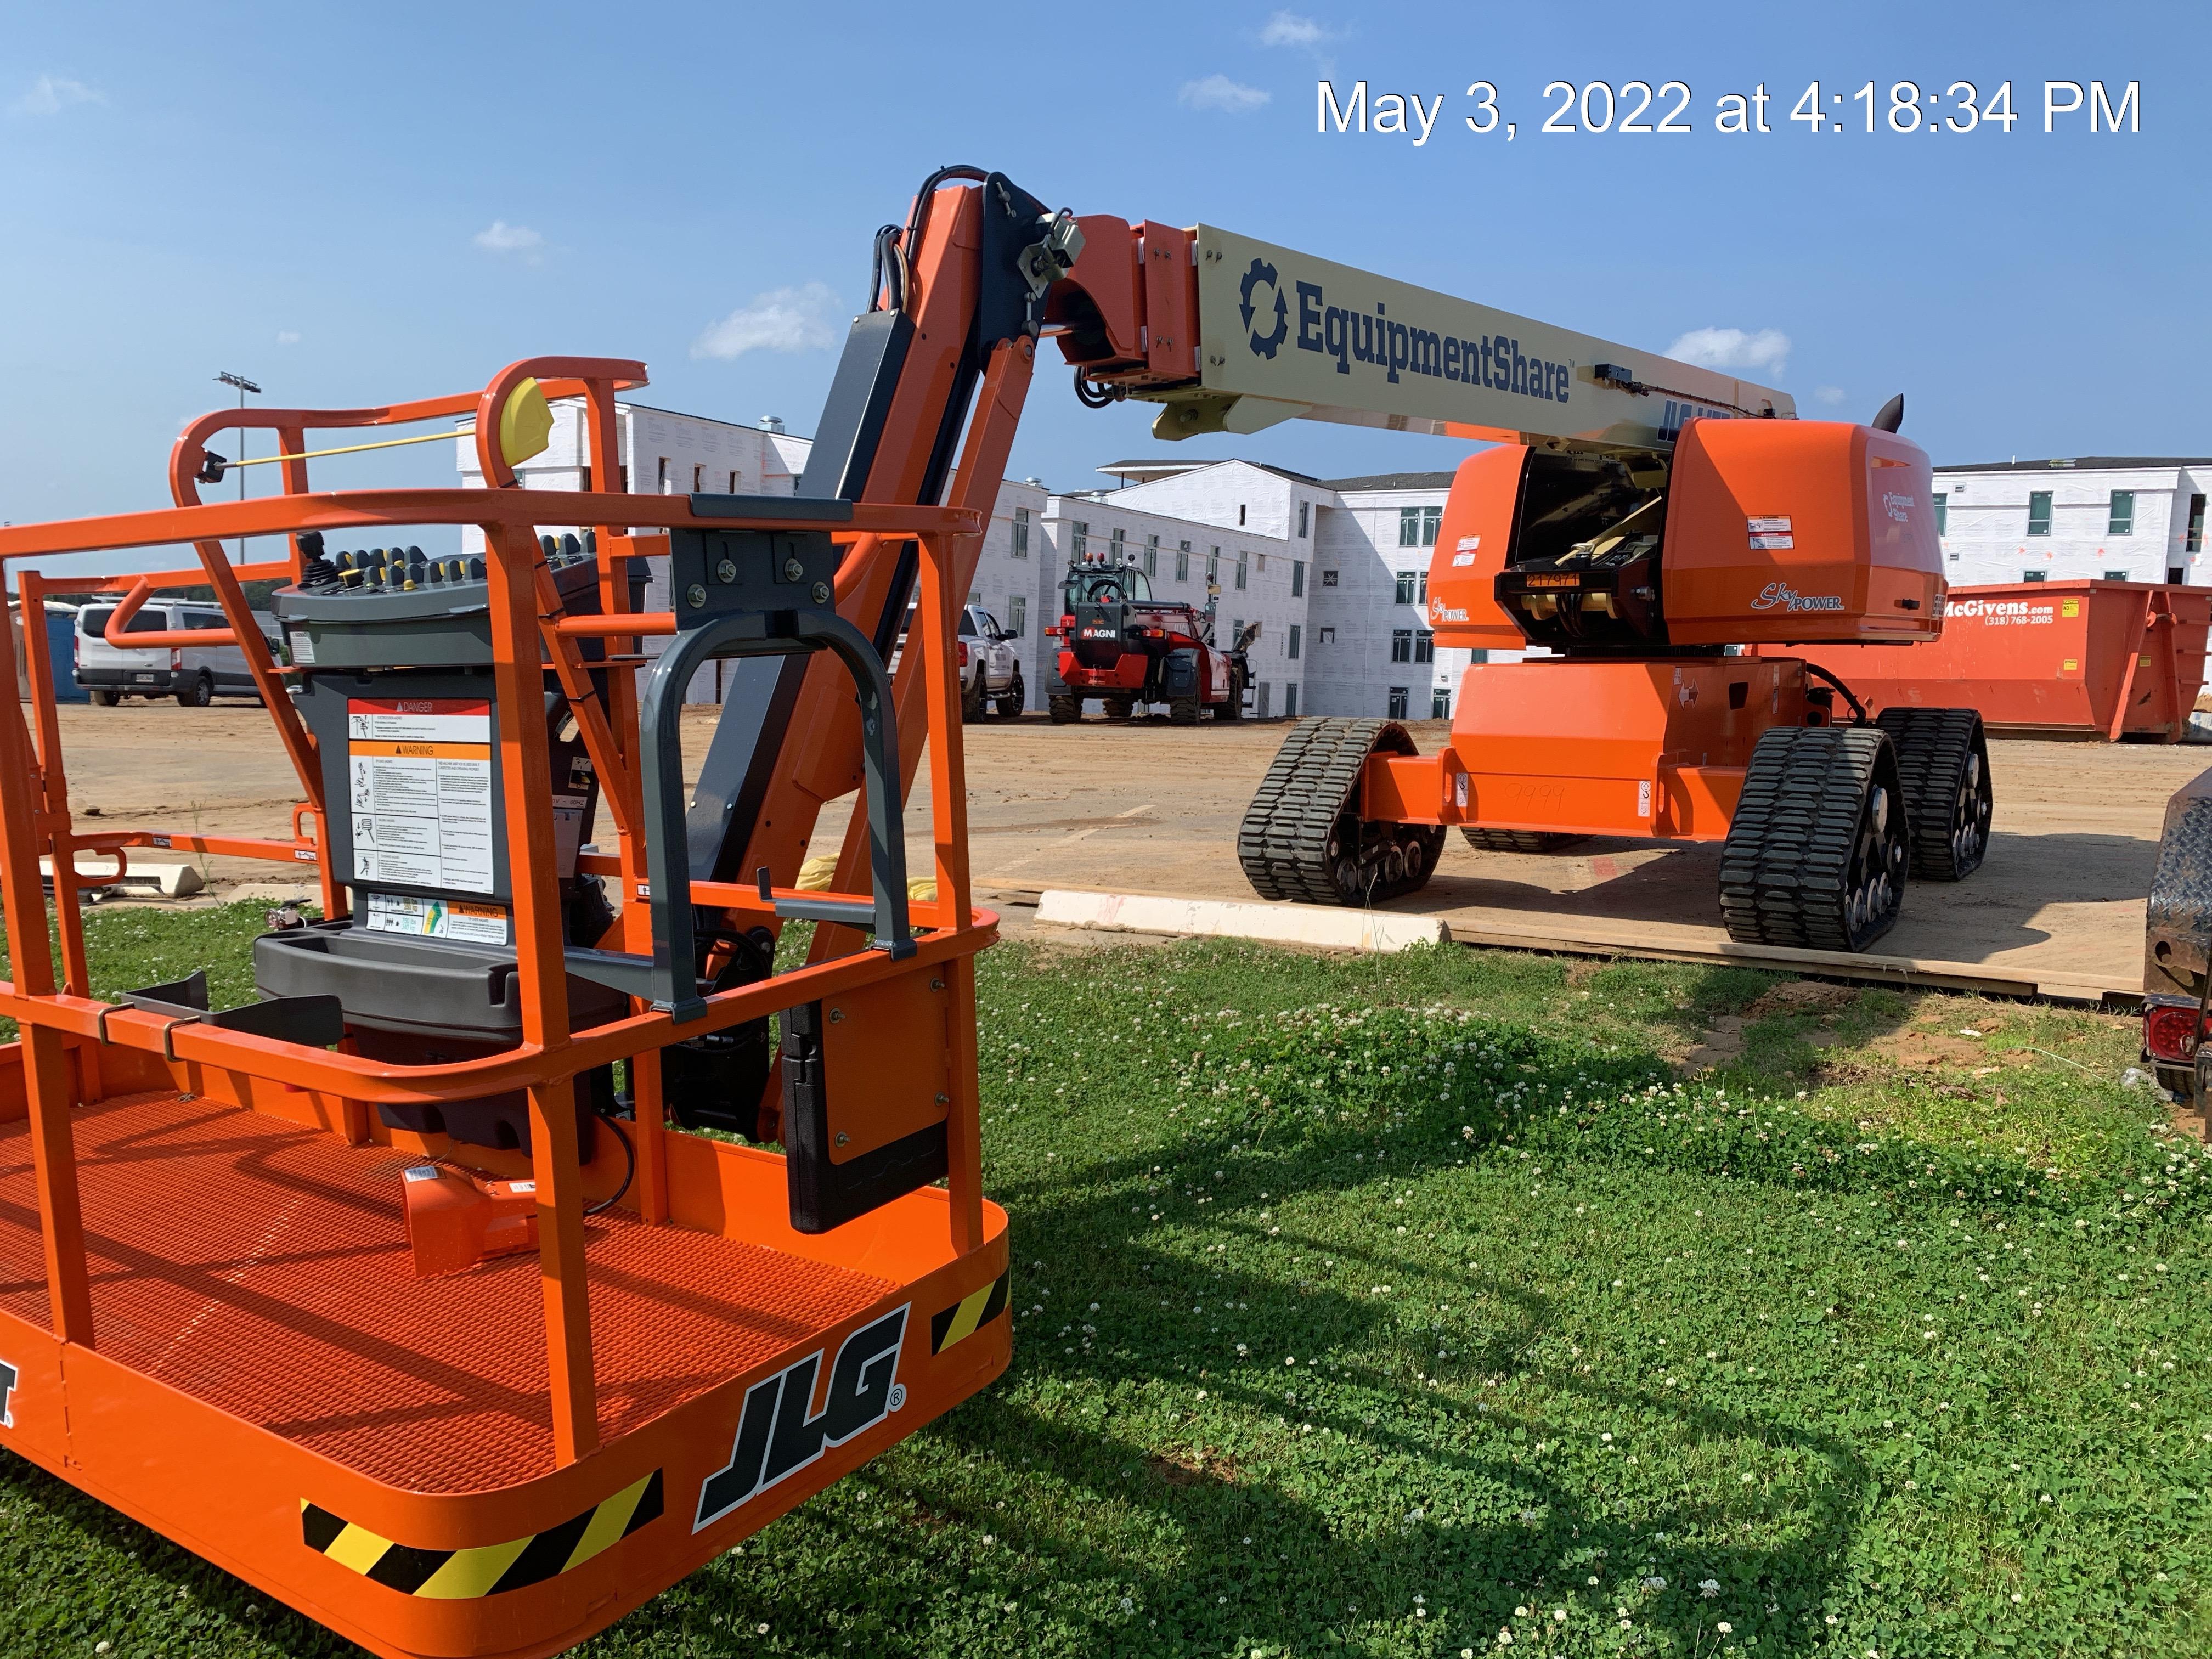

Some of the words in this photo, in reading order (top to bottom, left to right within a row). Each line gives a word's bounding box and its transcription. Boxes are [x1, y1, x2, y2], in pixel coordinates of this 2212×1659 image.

[1296, 280, 1570, 403] EquipmentShare
[1889, 492, 1915, 509] Equipment
[1528, 573, 1578, 586] 217971
[1984, 615, 2009, 625] (318)
[2011, 615, 2053, 624] 768-2005
[1084, 629, 1116, 638] MAGNI
[403, 702, 432, 713] DANGER
[402, 745, 434, 755] WARNING
[464, 905, 498, 917] WARNING
[692, 1301, 911, 1536] JLG
